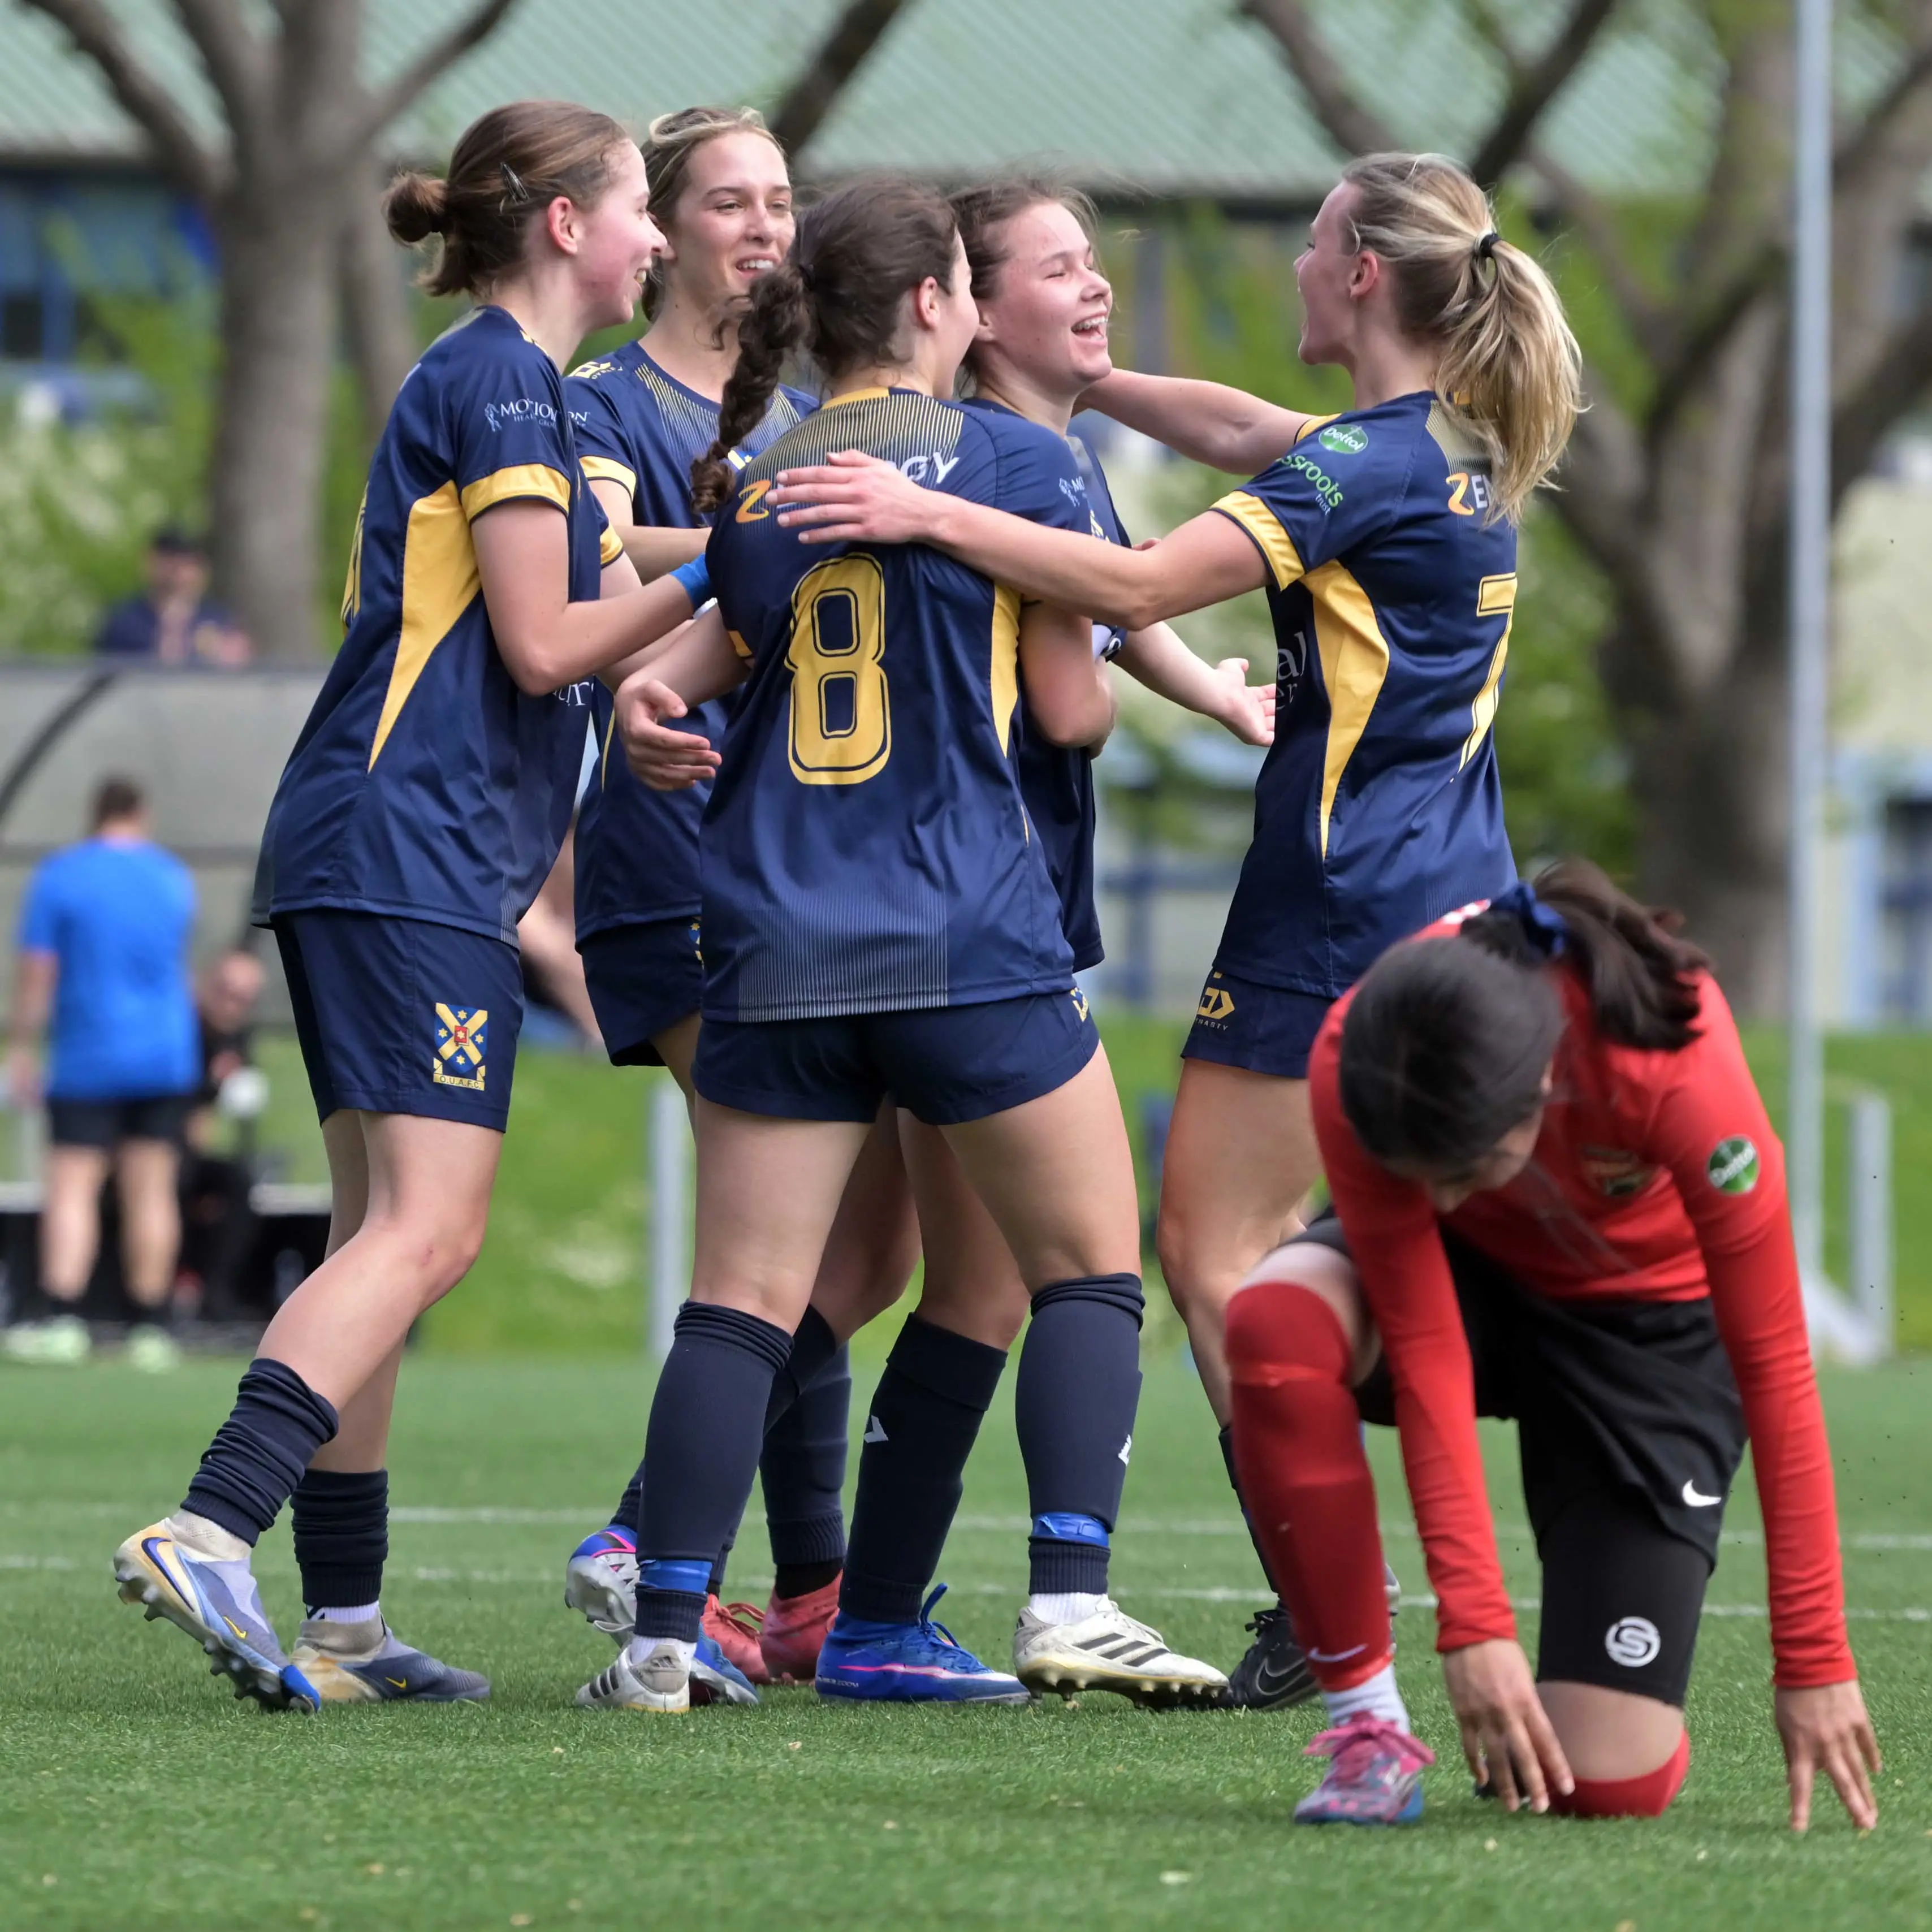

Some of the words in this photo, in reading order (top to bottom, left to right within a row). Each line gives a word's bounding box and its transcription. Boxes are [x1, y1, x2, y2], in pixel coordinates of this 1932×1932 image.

[1276, 454, 1343, 507] ssroots
[1323, 427, 1364, 451] Dettol
[784, 552, 892, 785] 8
[1457, 572, 1518, 775] 7
